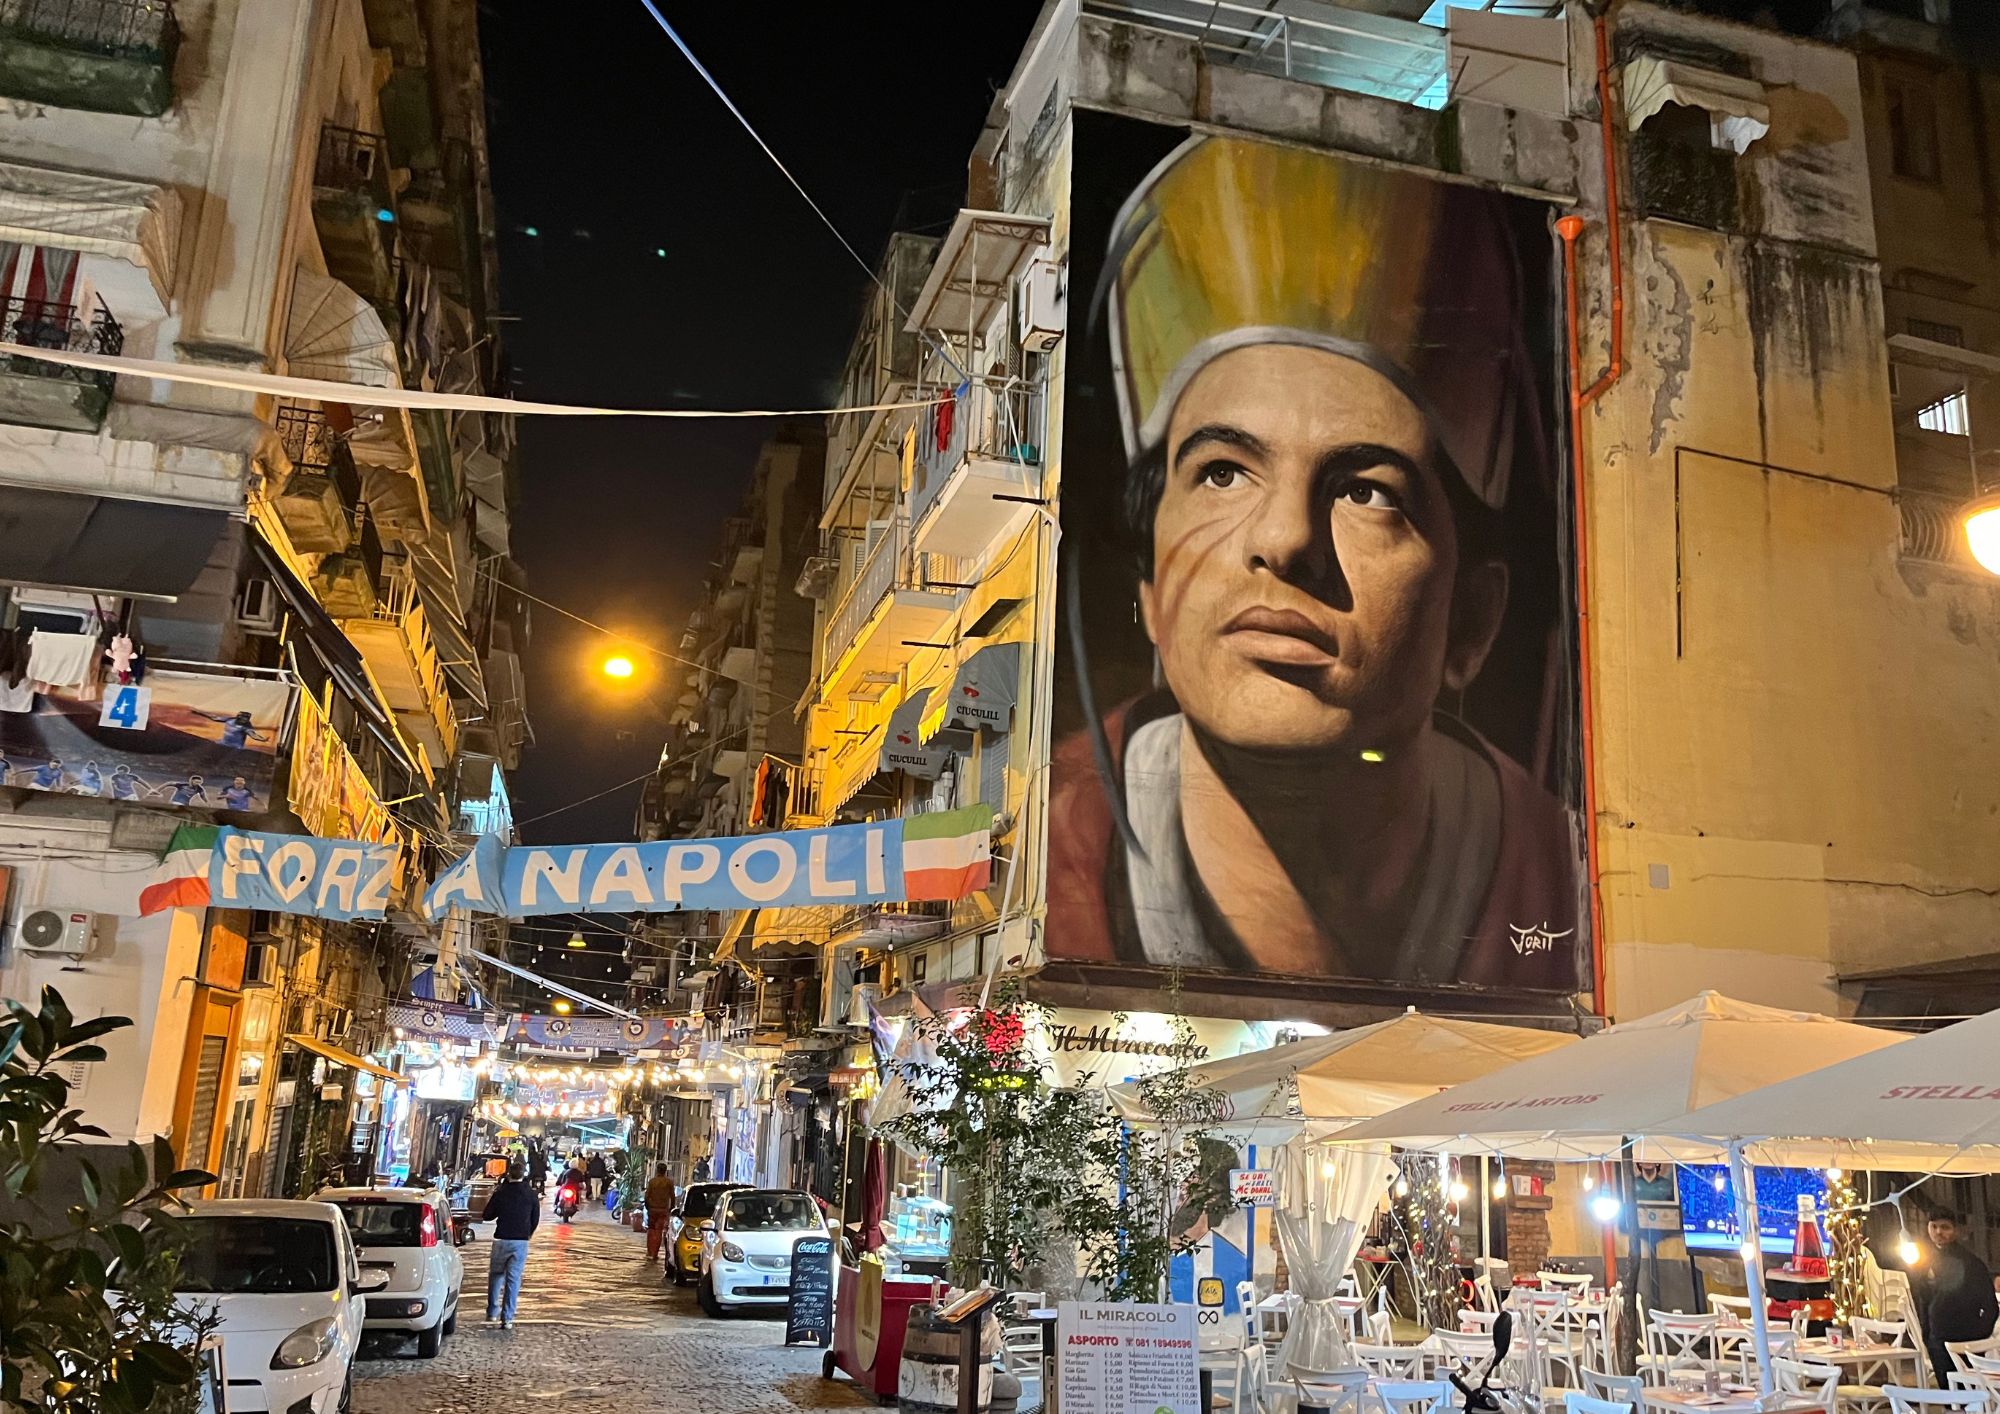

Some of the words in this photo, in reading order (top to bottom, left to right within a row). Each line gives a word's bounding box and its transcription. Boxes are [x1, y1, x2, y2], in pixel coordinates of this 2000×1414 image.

[109, 687, 138, 728] 4
[956, 705, 1000, 720] CIUCULILL
[888, 754, 927, 766] CIUCULILL
[520, 828, 886, 907] NAPOLI
[1509, 921, 1574, 955] JORIT
[1077, 1025, 1209, 1059] Miracolo
[1442, 1101, 1504, 1113] STELLA
[1519, 1094, 1604, 1108] ARTOIS
[797, 1241, 830, 1254] Coca-Cola
[1080, 1310, 1093, 1320] IL
[1097, 1310, 1177, 1323] MIRACOLO
[1068, 1335, 1119, 1346] ASPORTO
[1065, 1384, 1096, 1392] Capricciosa
